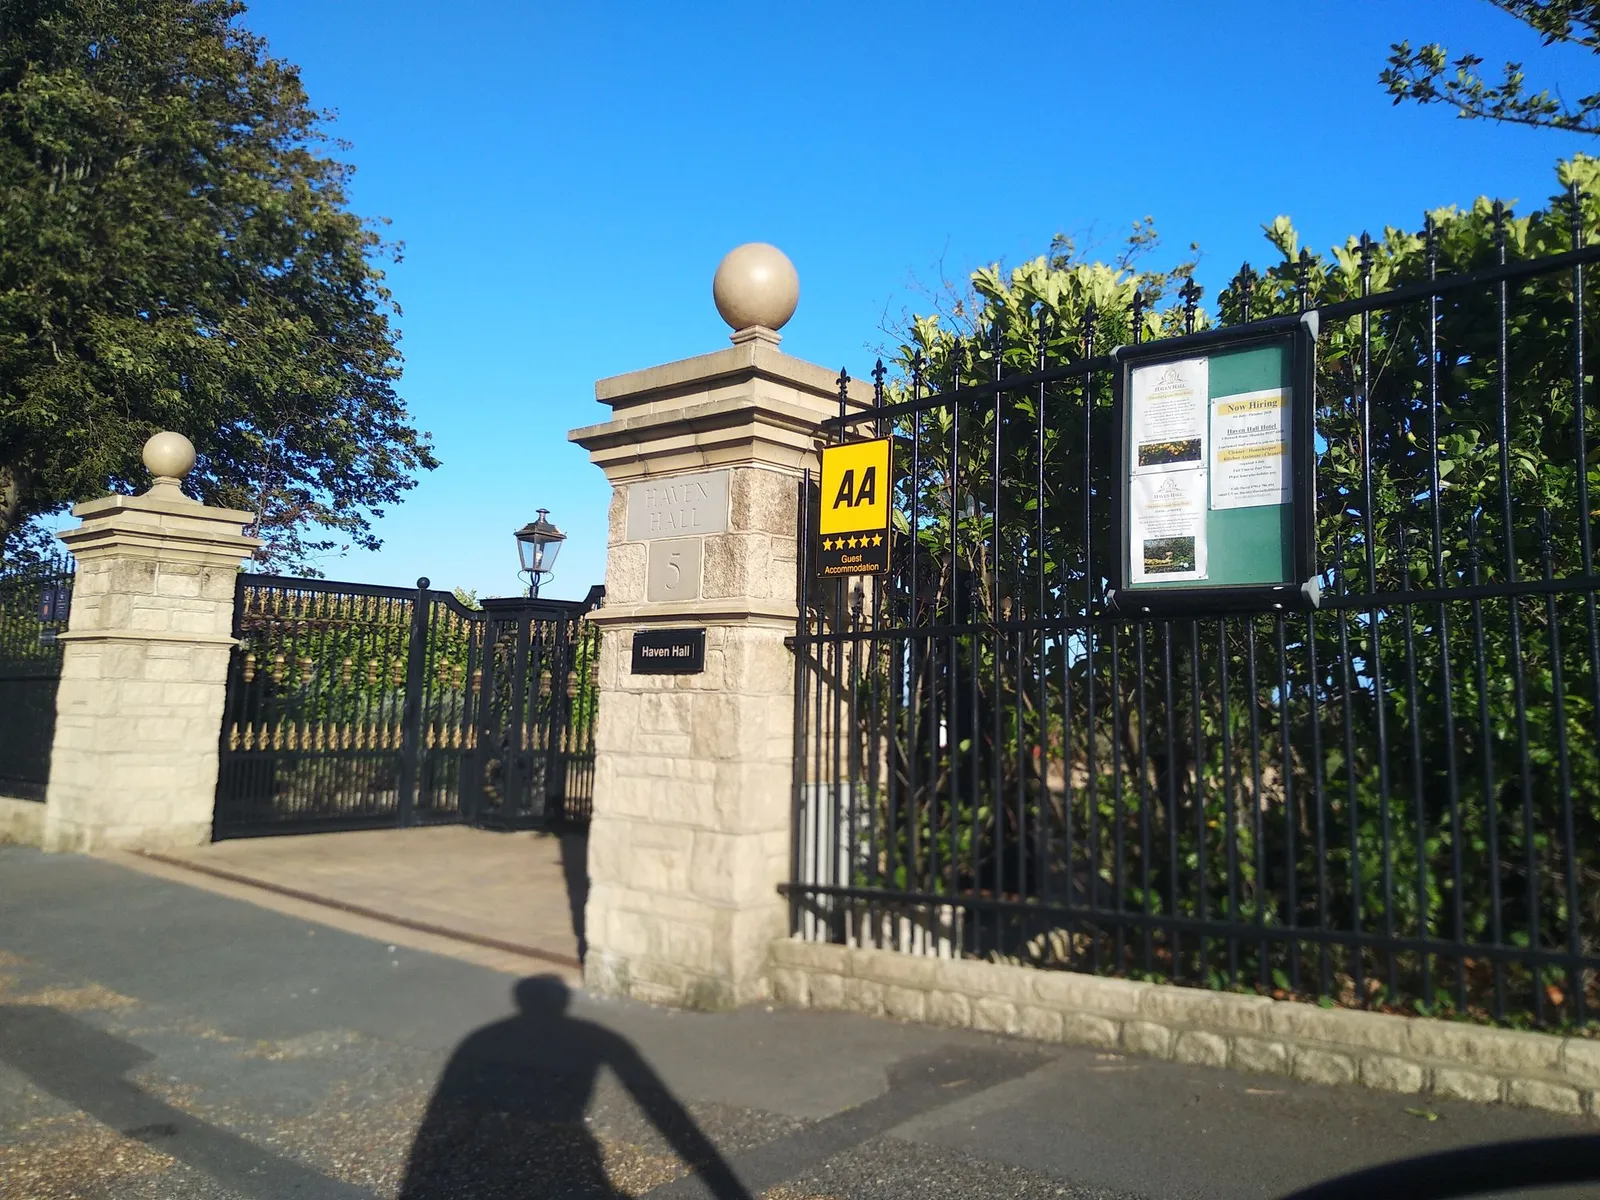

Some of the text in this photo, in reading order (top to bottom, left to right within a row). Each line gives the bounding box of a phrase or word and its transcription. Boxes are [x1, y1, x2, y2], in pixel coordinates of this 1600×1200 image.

[1228, 400, 1278, 413] Now Hiring
[646, 481, 709, 507] HAVEN
[832, 466, 876, 510] AA
[651, 508, 701, 531] HALL
[841, 554, 862, 563] Guest
[665, 552, 681, 590] 5
[824, 563, 879, 574] Accommodation
[641, 645, 690, 657] Haven Hall
